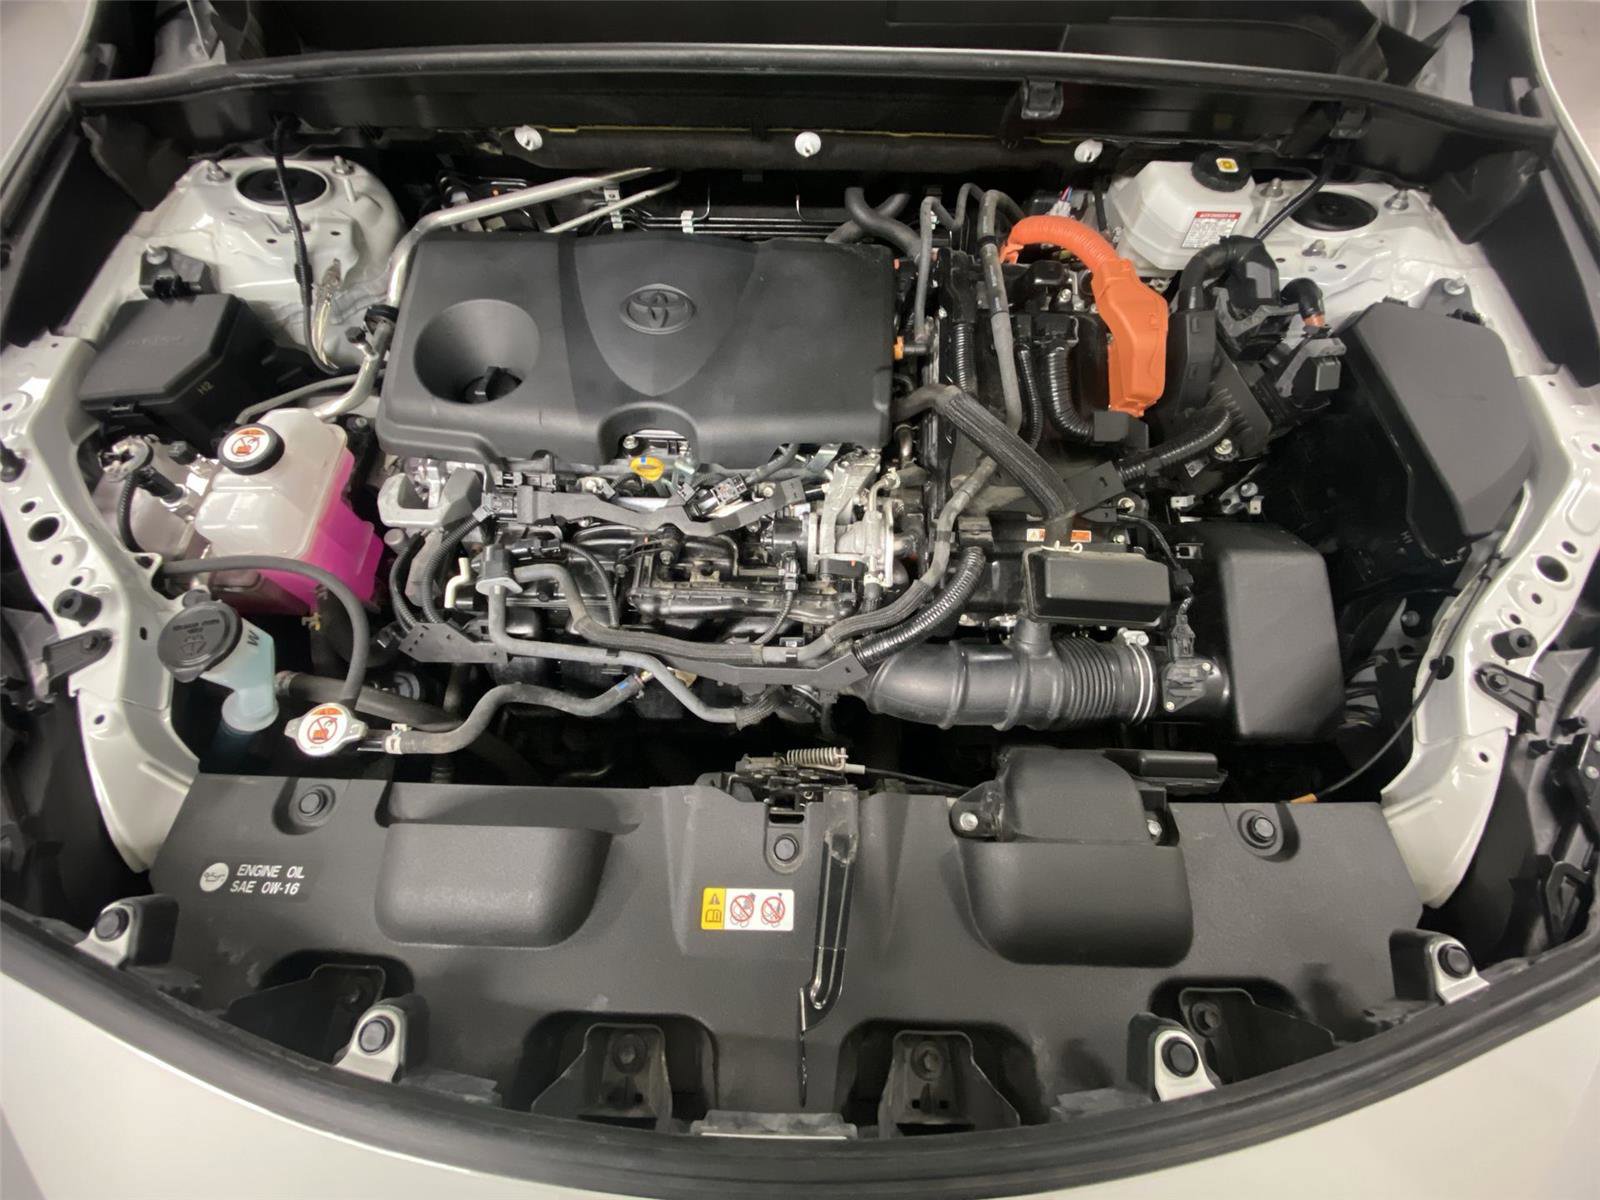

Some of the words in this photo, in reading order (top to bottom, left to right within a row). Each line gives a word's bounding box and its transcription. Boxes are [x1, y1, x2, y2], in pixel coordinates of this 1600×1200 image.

[236, 864, 282, 878] ENGINE
[286, 865, 305, 879] OIL
[229, 880, 257, 893] SAE
[260, 881, 301, 895] 0W-16
